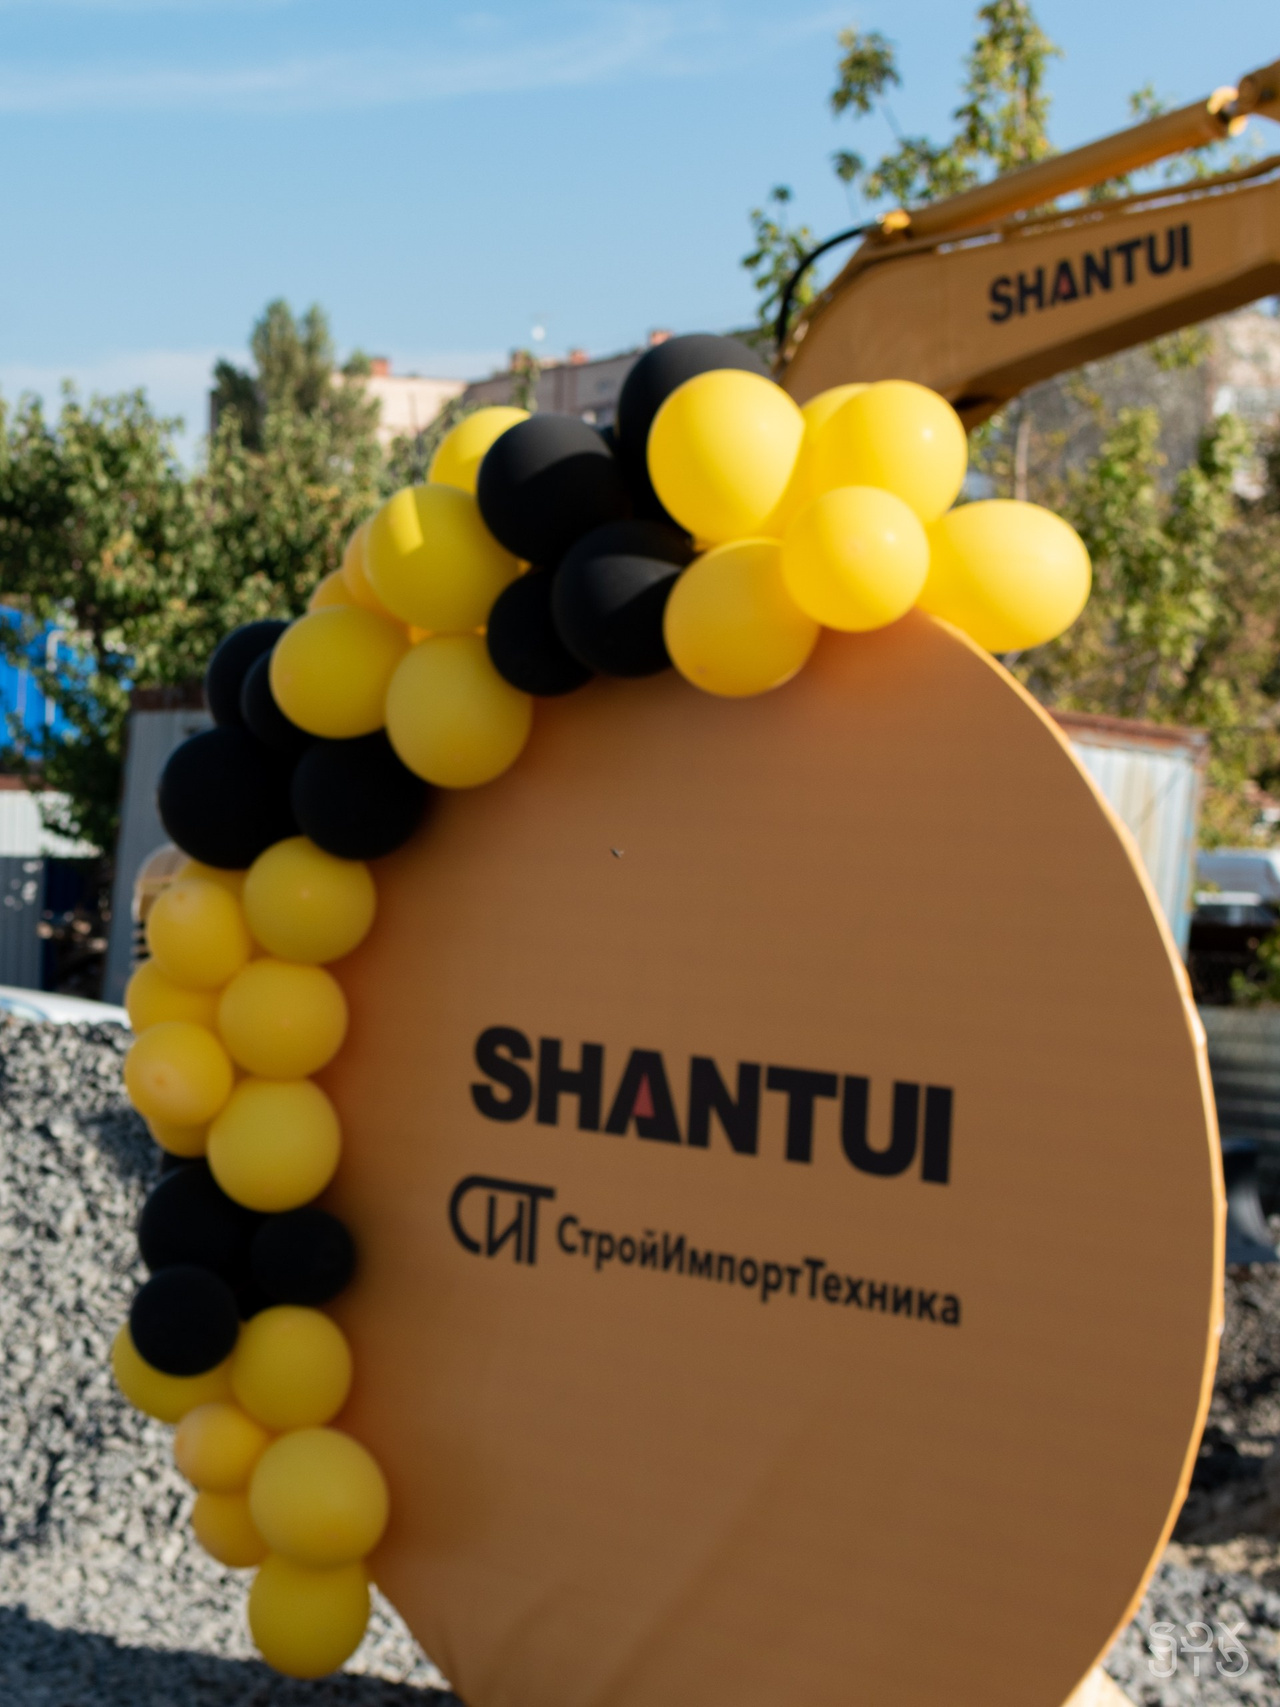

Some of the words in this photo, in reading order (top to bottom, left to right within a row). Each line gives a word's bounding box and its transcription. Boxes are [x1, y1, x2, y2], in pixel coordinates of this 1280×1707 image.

[989, 223, 1191, 323] SHANTUI
[470, 1025, 954, 1186] SHANTUI
[556, 1214, 962, 1328] СтройИмпортТехника
